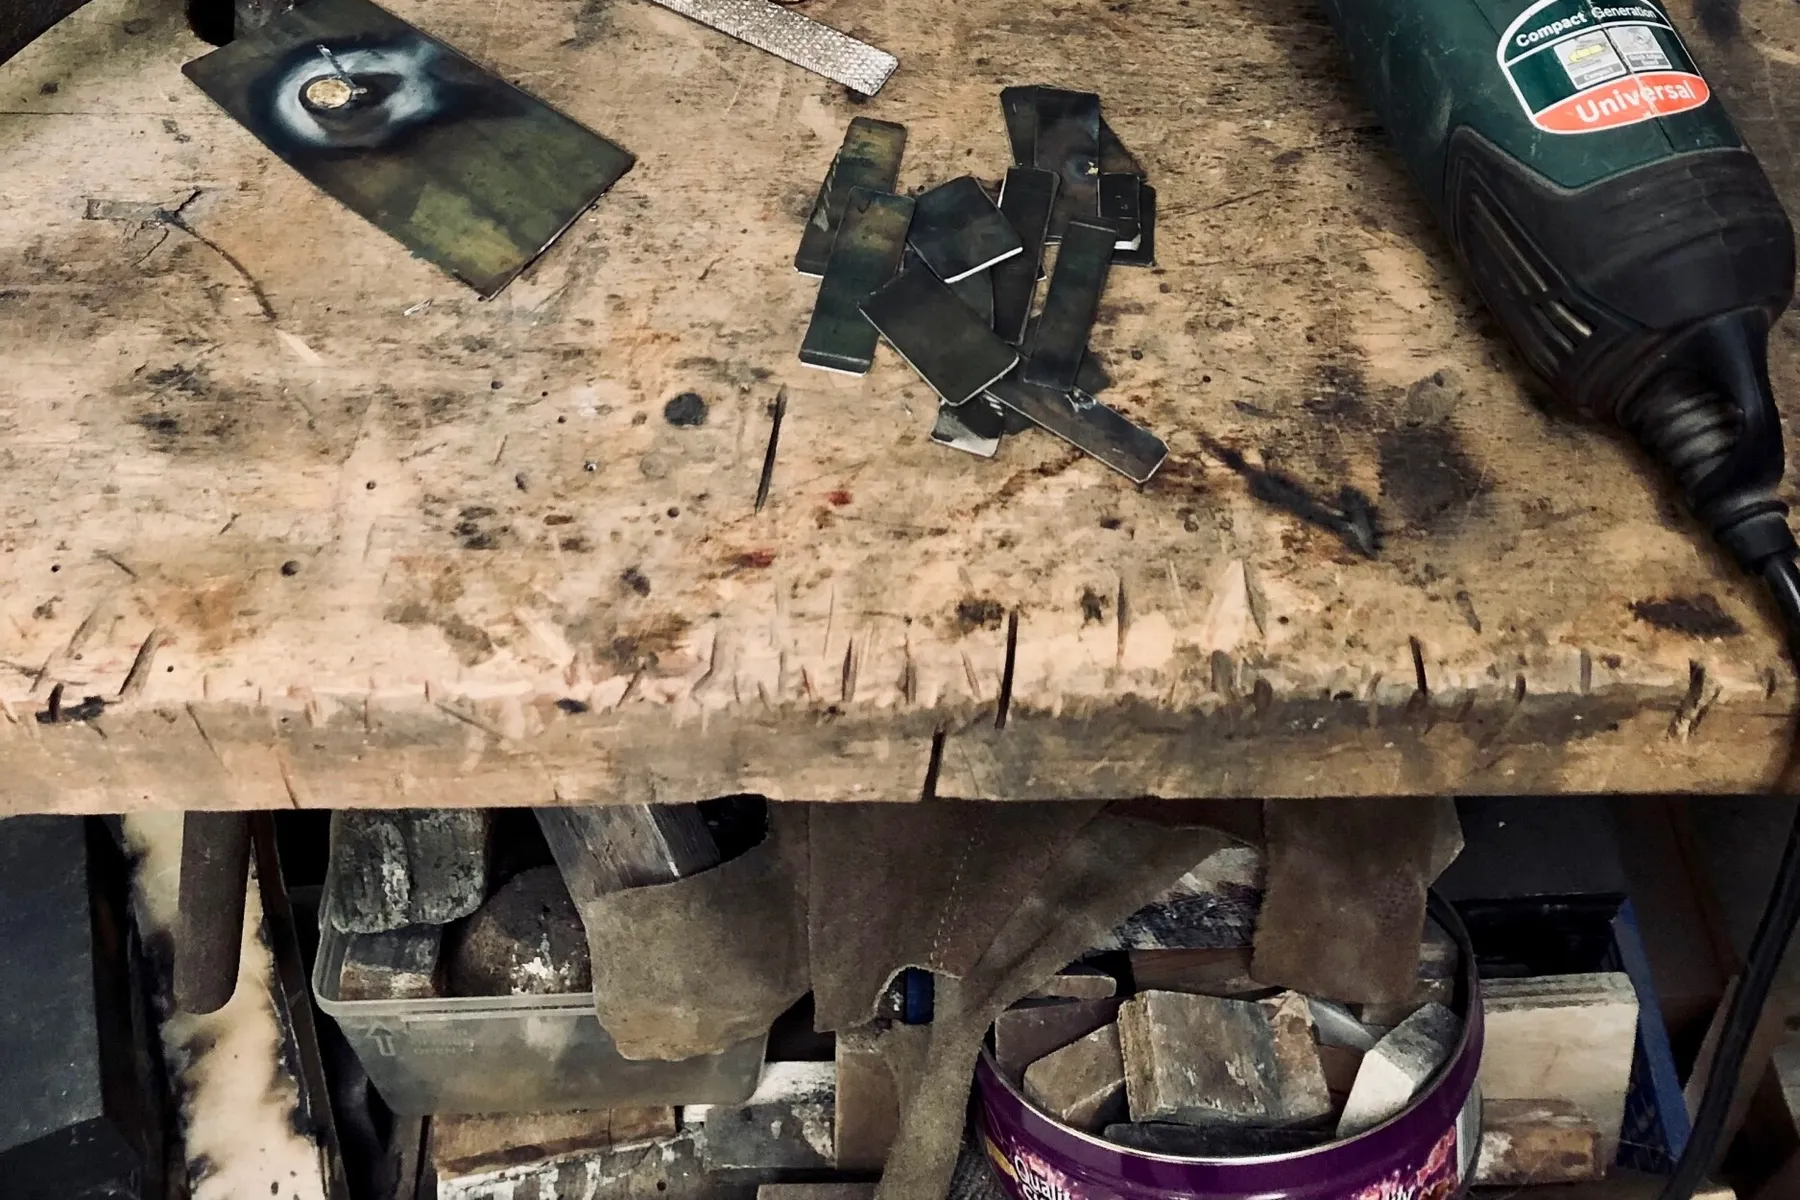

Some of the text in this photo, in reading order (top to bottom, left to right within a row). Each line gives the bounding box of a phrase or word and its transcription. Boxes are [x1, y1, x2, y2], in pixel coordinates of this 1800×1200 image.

[1516, 6, 1657, 47] Compact Generation
[1574, 80, 1696, 124] Universal
